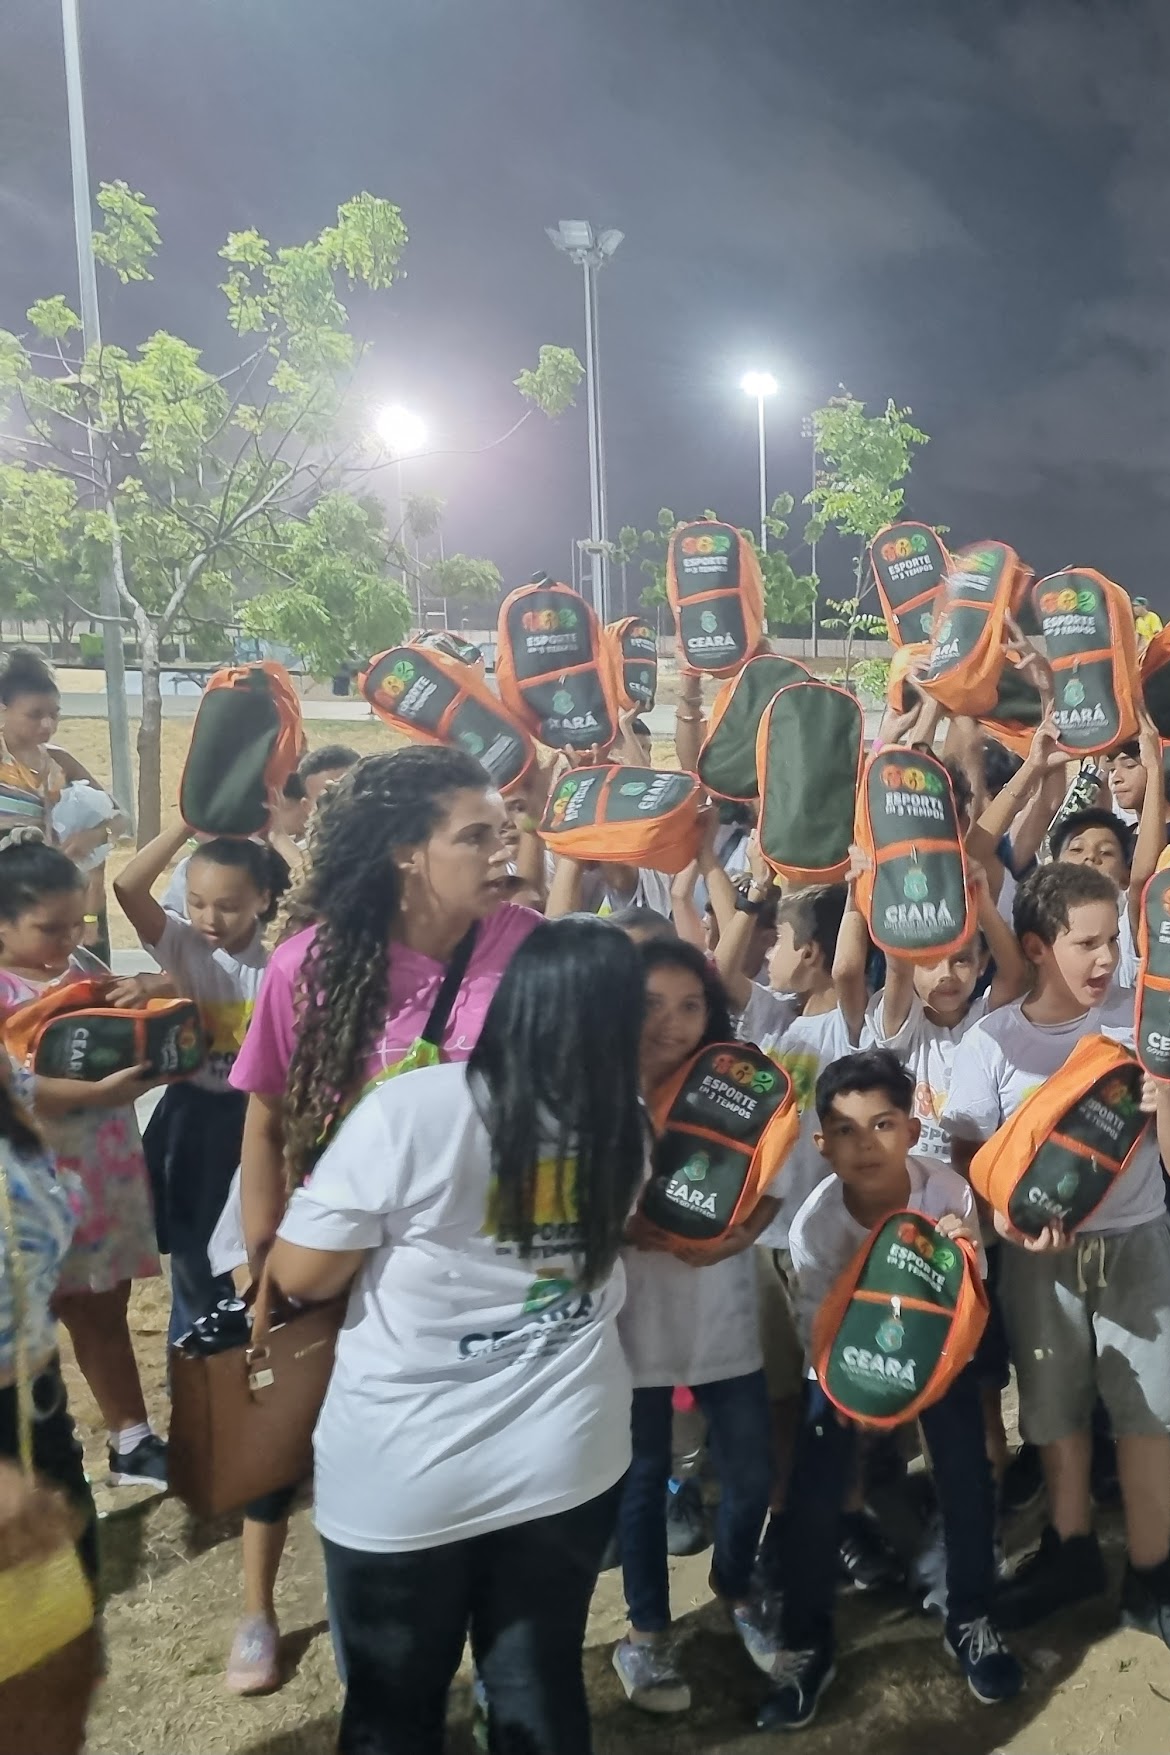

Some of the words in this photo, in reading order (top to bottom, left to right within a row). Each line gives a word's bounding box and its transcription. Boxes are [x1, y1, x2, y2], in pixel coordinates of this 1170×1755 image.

[888, 555, 932, 576] ESPORTE
[905, 564, 934, 579] TEMPOS
[1043, 614, 1096, 630] ESPORTE
[687, 632, 736, 648] CEARÁ
[1052, 703, 1106, 725] CEARÁ
[884, 898, 953, 924] CEARÁ
[69, 1027, 90, 1078] CEAR
[699, 1084, 709, 1095] EM
[716, 1095, 751, 1120] TEMPOS
[702, 1075, 758, 1111] ESPORTE
[665, 1179, 717, 1213] EARÁ
[889, 1243, 946, 1284] ESPORTE
[842, 1346, 917, 1385] CEARÁ
